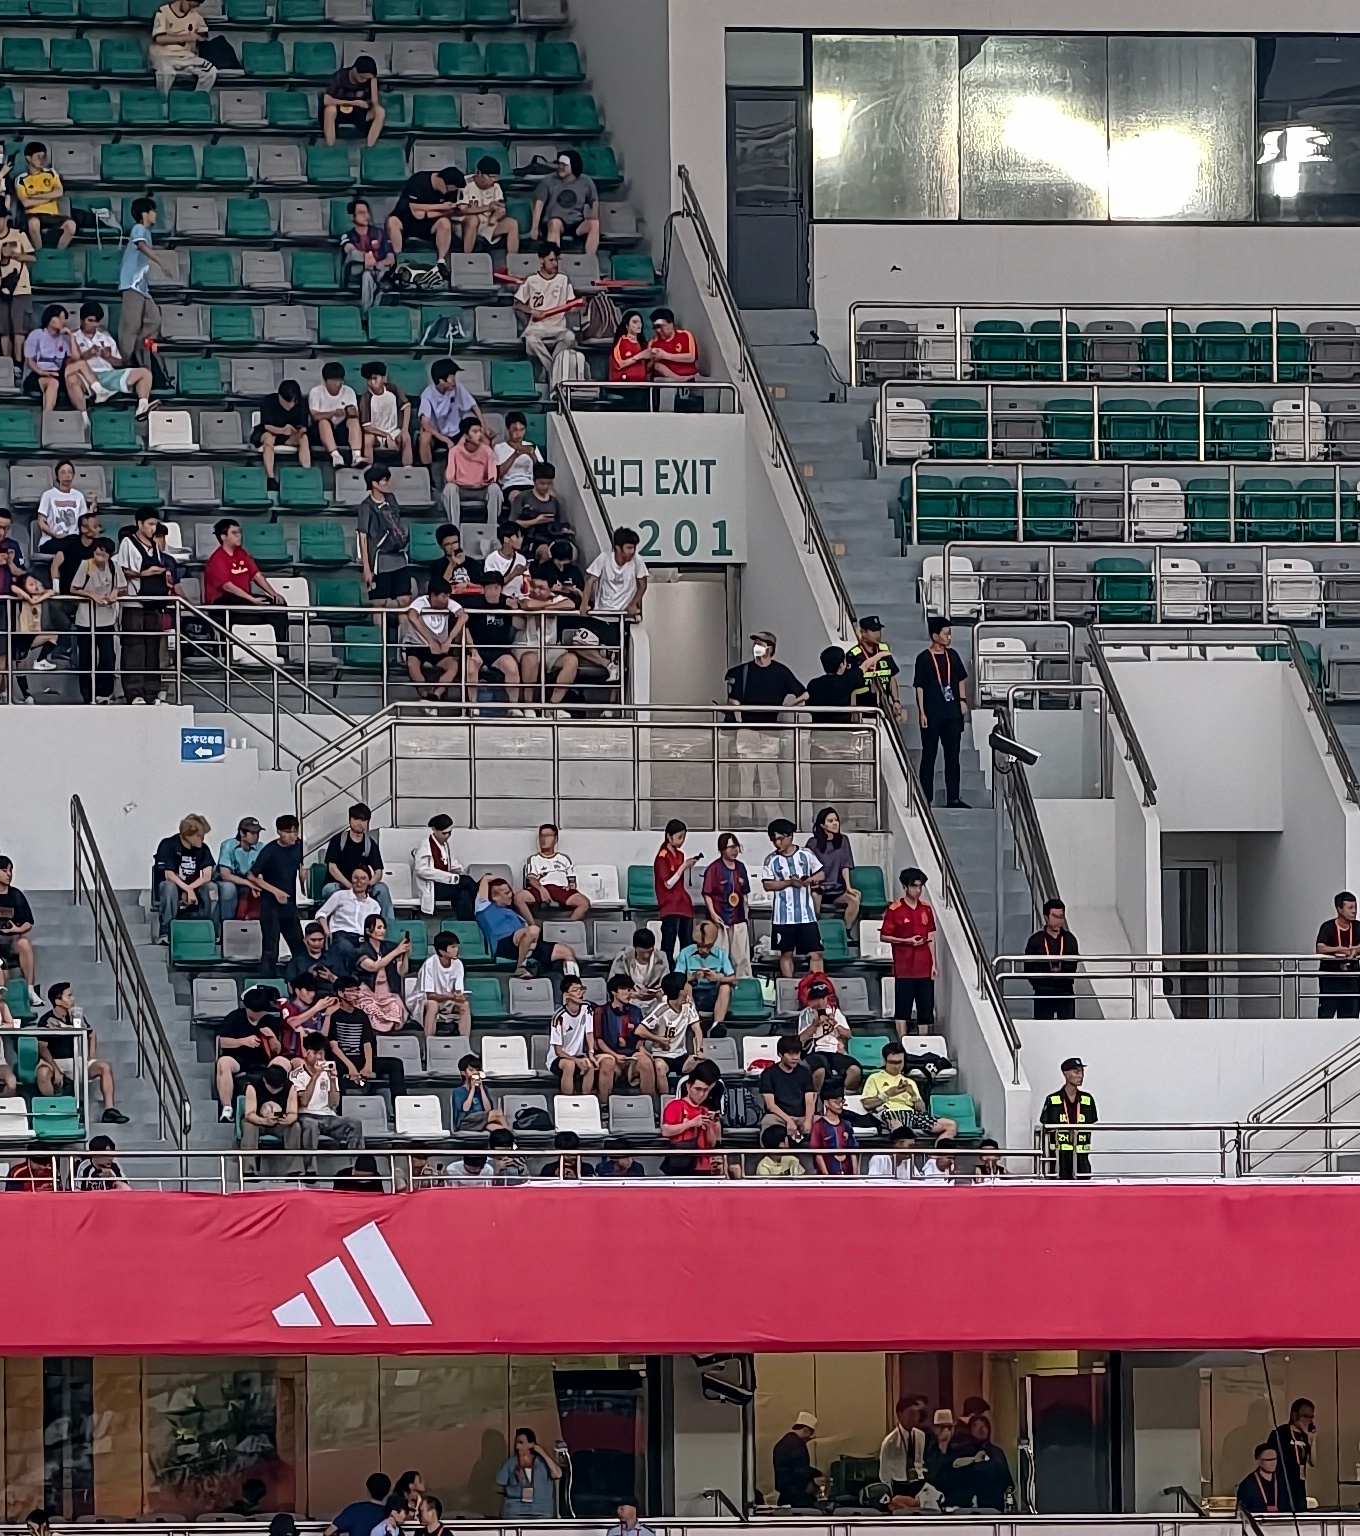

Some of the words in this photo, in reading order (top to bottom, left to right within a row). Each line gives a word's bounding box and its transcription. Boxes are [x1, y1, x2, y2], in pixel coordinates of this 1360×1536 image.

[593, 455, 643, 497] 出口
[655, 459, 716, 495] EXIT
[638, 519, 733, 557] 201
